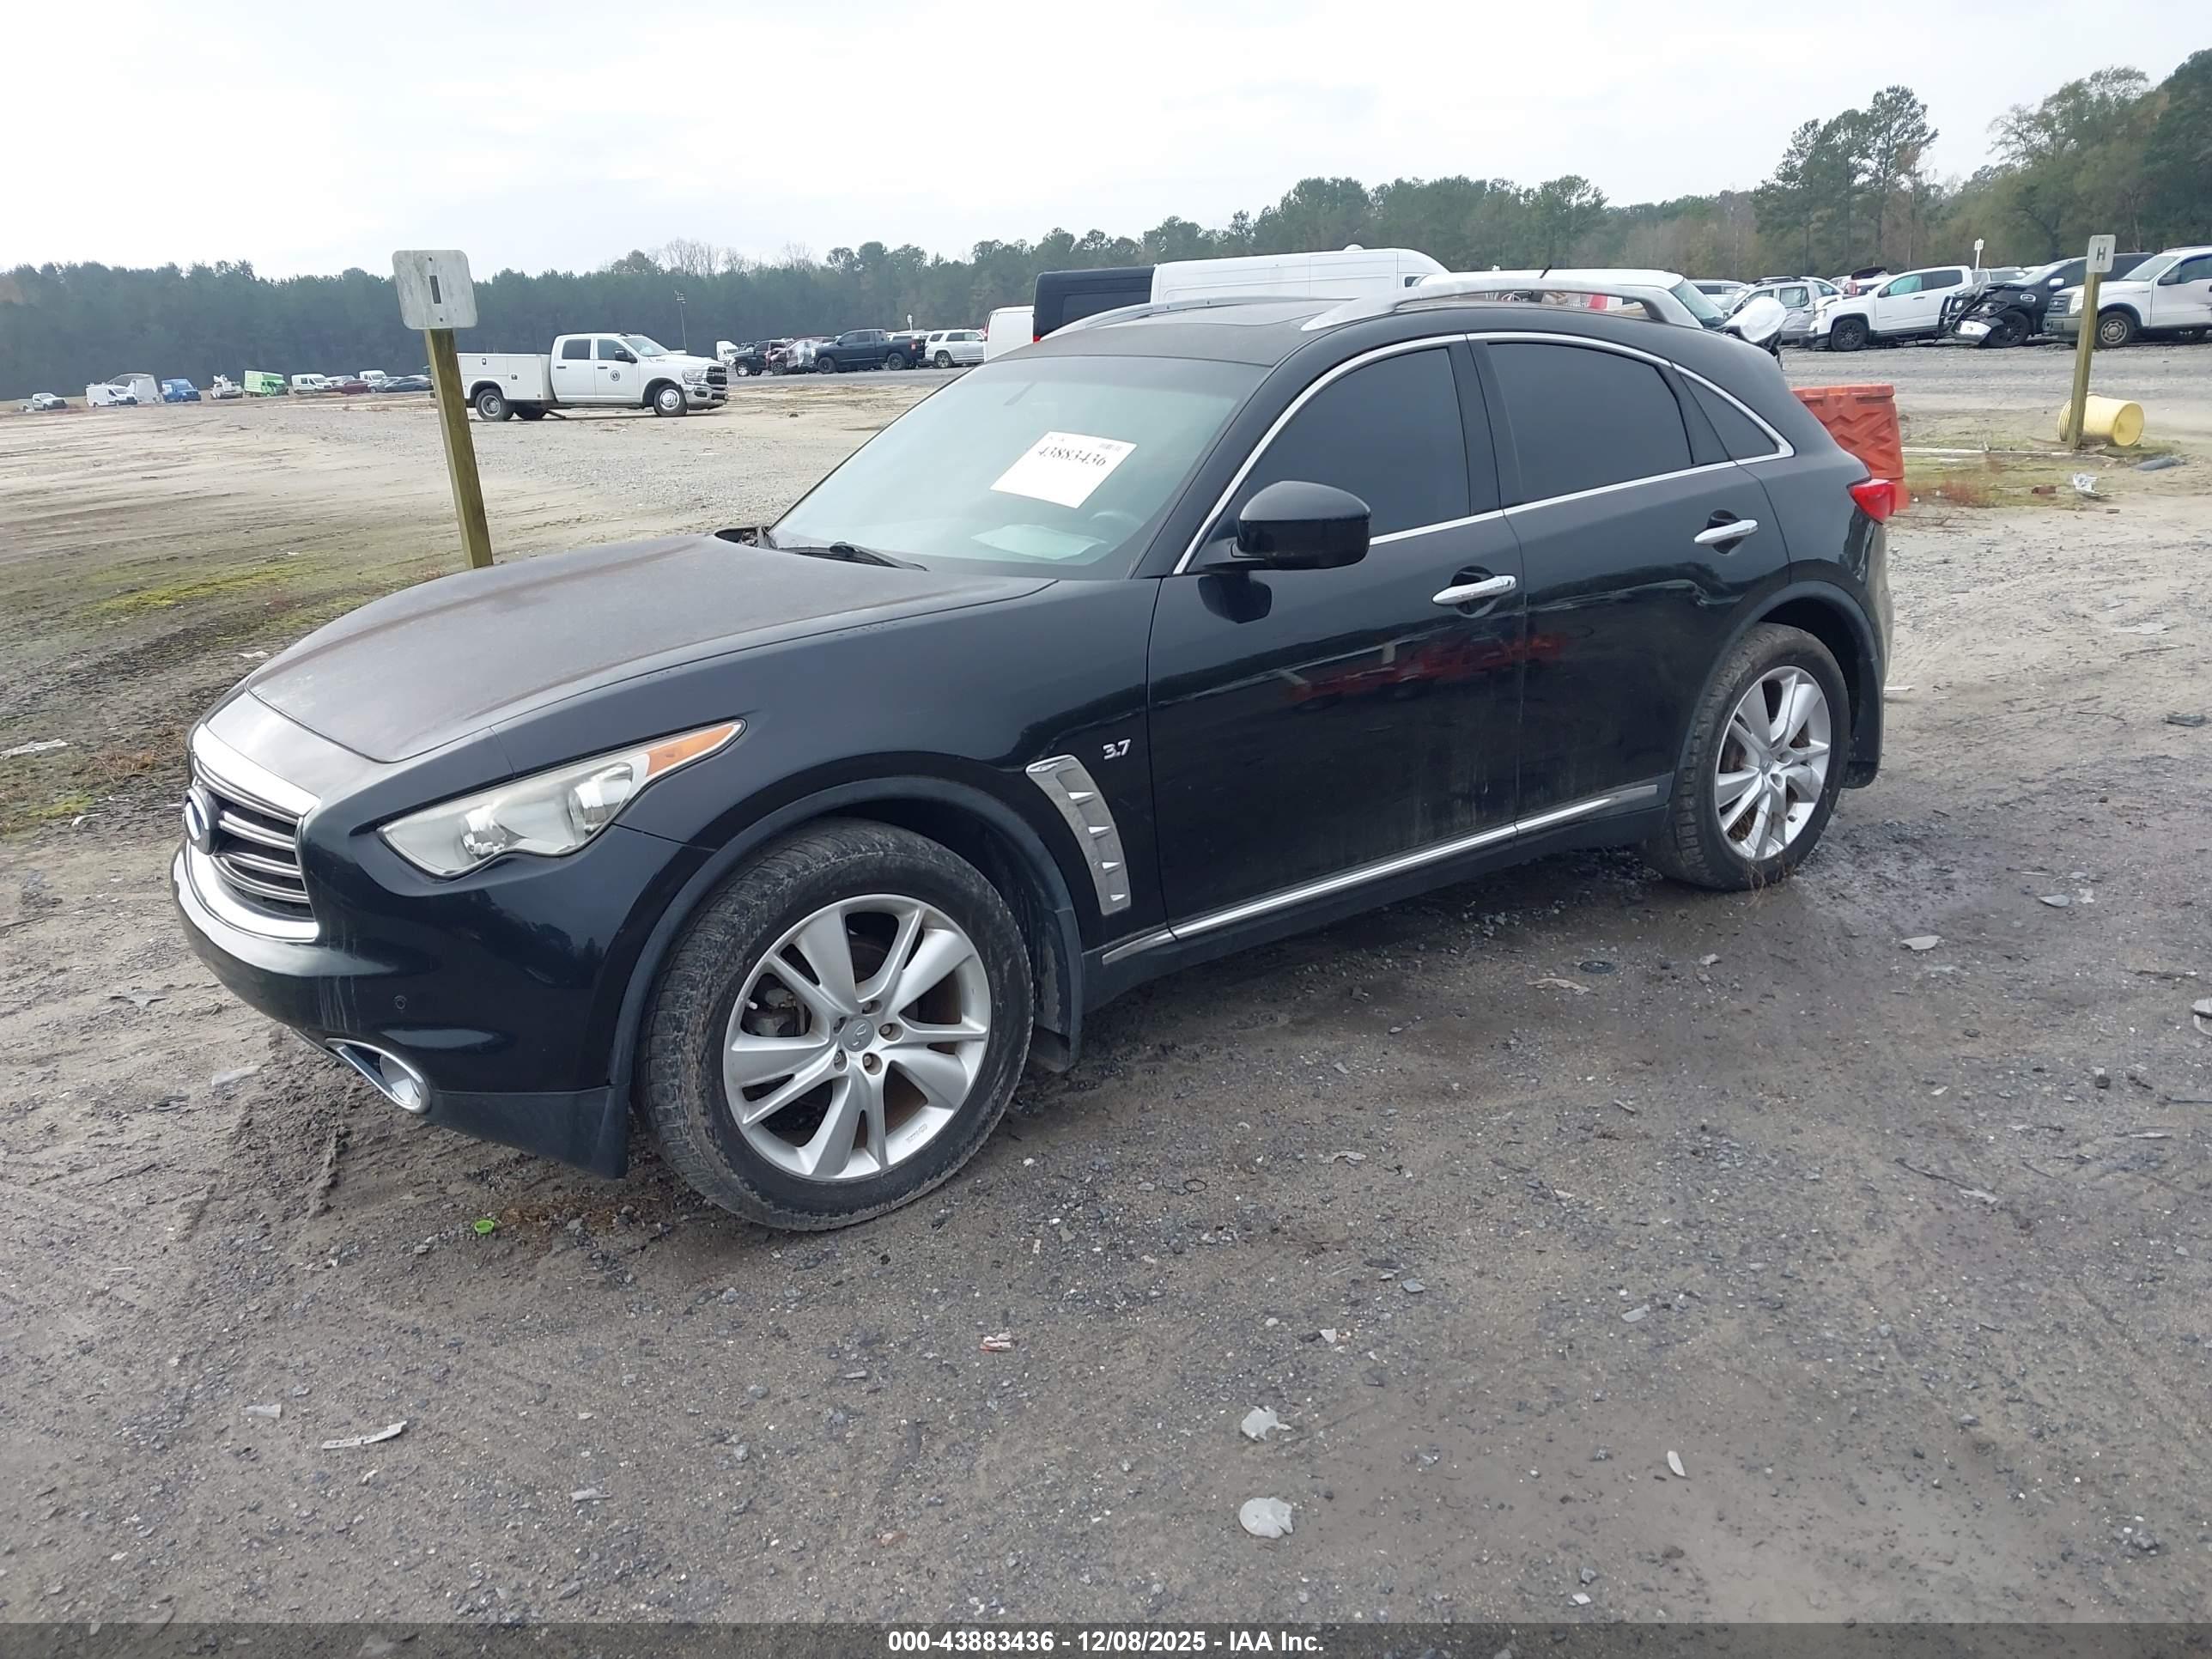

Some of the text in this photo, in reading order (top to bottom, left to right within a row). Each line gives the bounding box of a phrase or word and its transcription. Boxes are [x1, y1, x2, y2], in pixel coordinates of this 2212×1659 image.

[2096, 246, 2106, 261] H
[1038, 446, 1107, 467] 43883436
[1103, 738, 1131, 760] 3.7
